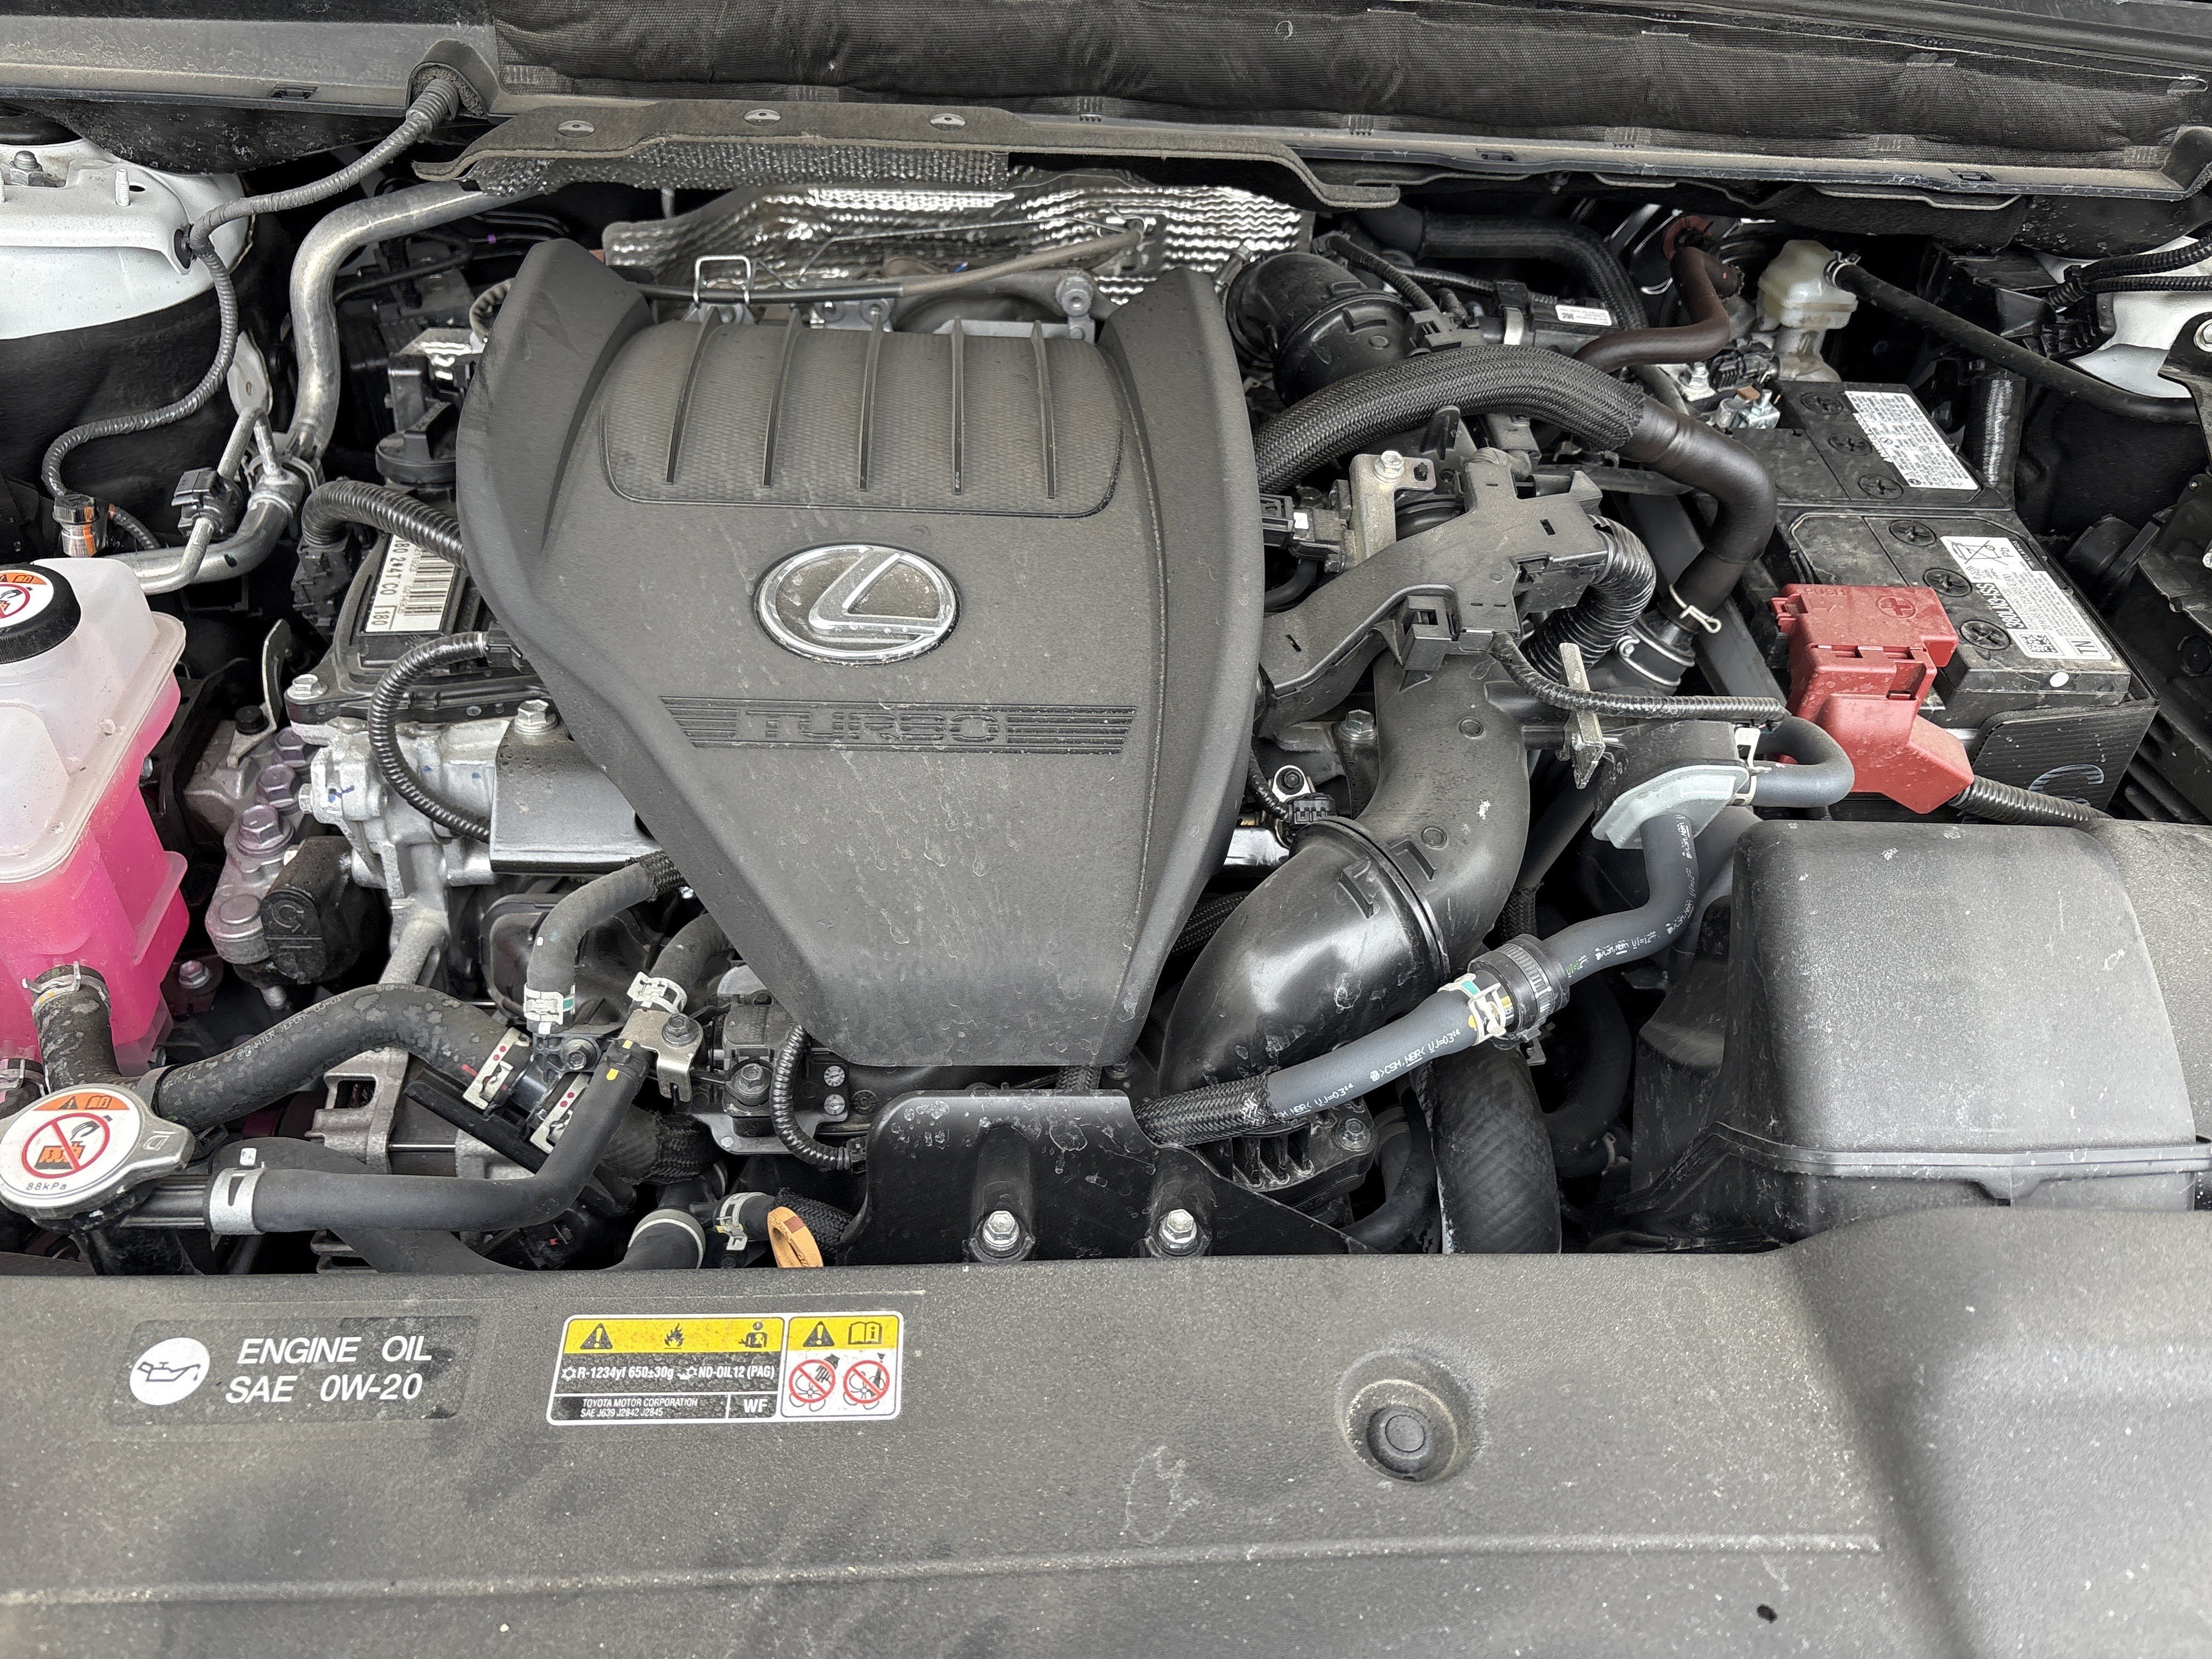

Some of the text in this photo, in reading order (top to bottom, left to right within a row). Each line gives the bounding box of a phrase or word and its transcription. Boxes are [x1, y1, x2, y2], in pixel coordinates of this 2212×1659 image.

[2000, 547, 2014, 557] Pb
[1976, 583, 2024, 628] 380LN3-ISS
[371, 611, 391, 625] 180
[2071, 640, 2099, 654] TN
[746, 710, 999, 743] TURBO
[26, 1182, 67, 1190] 88kPa
[237, 1335, 432, 1364] ENGINE OIL
[577, 1366, 627, 1381] R-1234yf
[628, 1365, 674, 1380] 650±30g
[747, 1365, 775, 1380] (PAG)
[225, 1372, 423, 1403] SAE 0W-20
[583, 1398, 699, 1407] TOYOTA MOTOR CORPORATION
[743, 1398, 768, 1413] WF
[580, 1408, 596, 1417] SAE
[597, 1408, 616, 1417] J639
[640, 1407, 664, 1417] J2845
